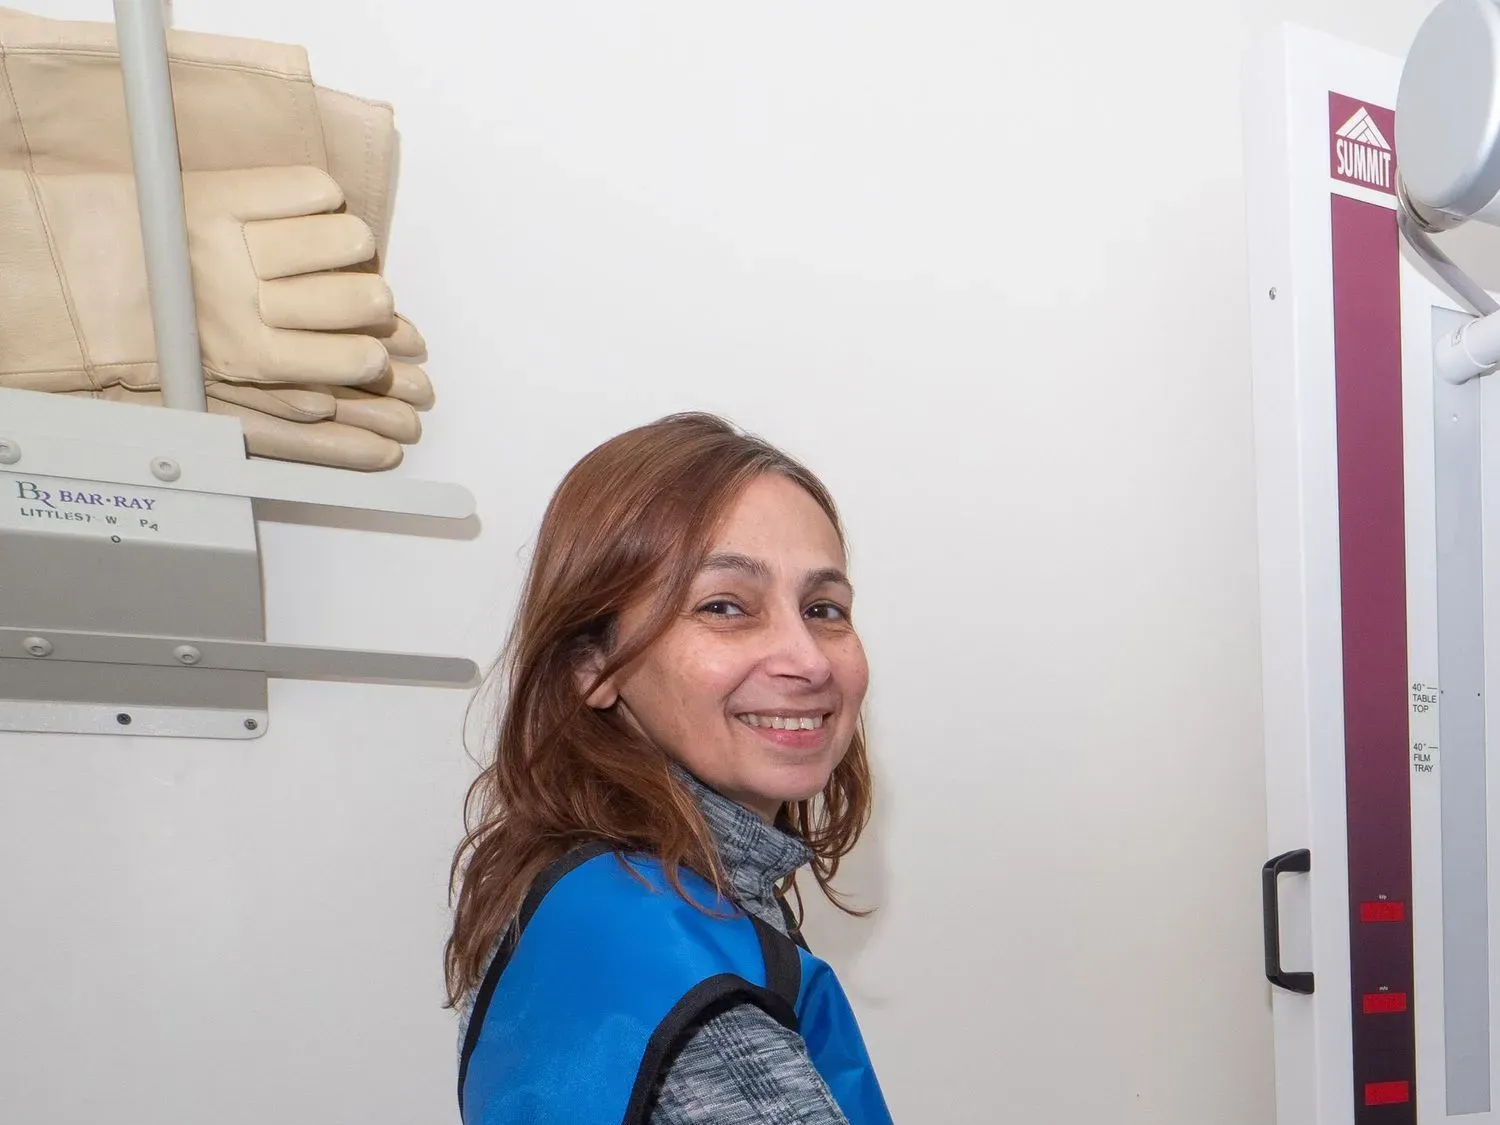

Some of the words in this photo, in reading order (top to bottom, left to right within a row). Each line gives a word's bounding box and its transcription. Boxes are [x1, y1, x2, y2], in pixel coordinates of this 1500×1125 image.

[1336, 138, 1391, 188] SUMMIT
[1412, 694, 1437, 703] TABLE
[1412, 704, 1429, 713] TOP
[1413, 753, 1431, 762] FILM
[1414, 764, 1434, 772] TRAY
